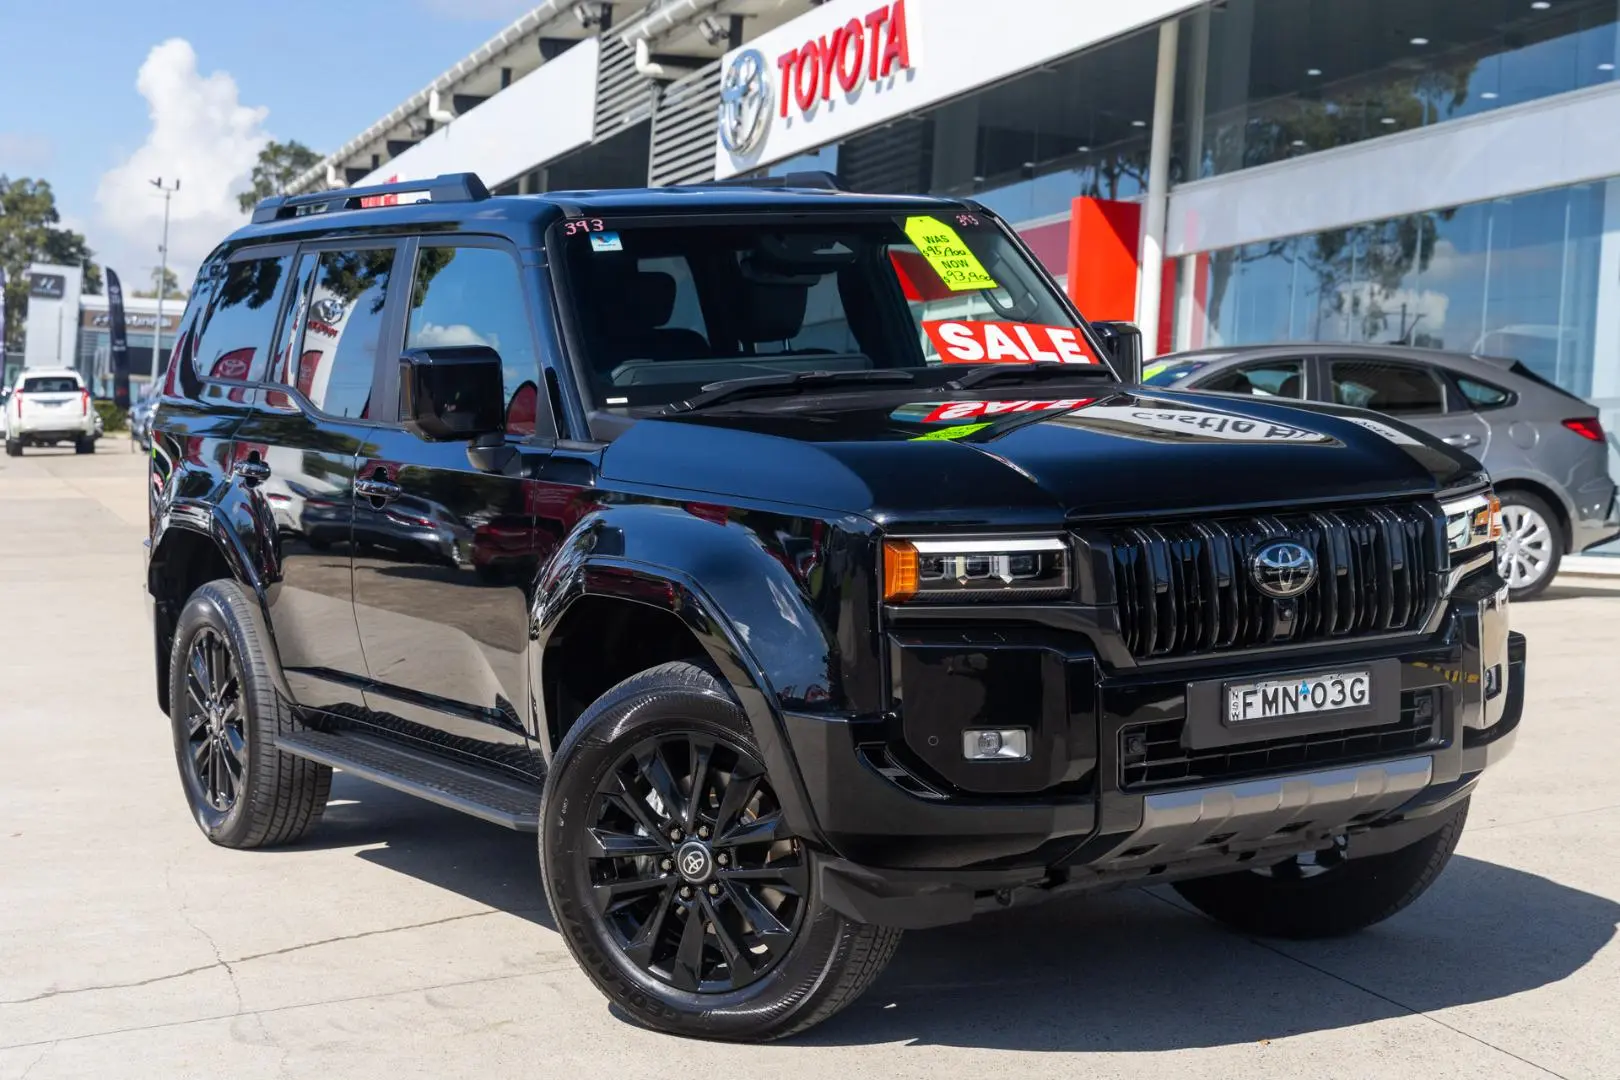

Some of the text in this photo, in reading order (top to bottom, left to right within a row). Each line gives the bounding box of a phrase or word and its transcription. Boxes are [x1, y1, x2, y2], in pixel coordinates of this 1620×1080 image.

[777, 0, 910, 118] TOYOTA
[564, 218, 604, 235] 393
[922, 235, 950, 244] WAS
[941, 259, 969, 269] NOW
[938, 322, 1091, 364] SALE
